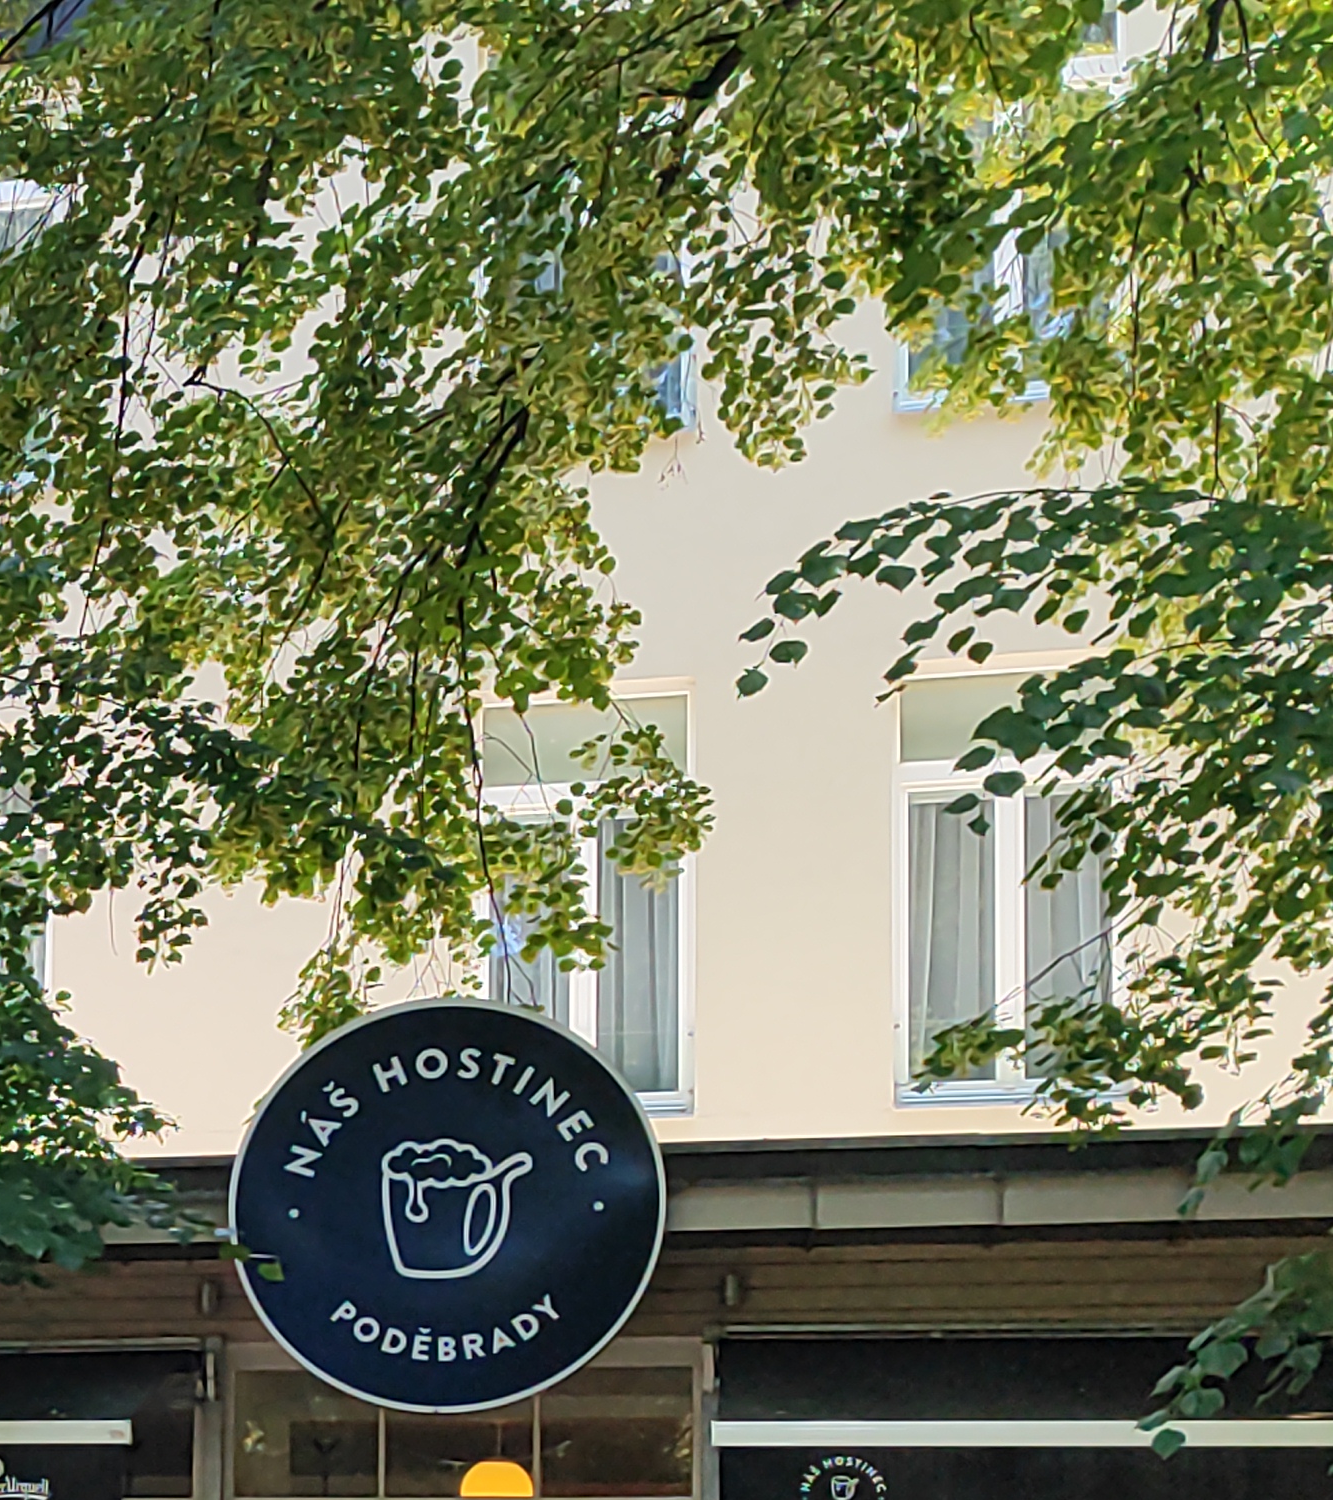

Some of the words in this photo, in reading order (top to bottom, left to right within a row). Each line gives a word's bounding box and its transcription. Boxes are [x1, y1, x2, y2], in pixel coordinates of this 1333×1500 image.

[284, 1081, 360, 1178] NÁŠ
[372, 1047, 609, 1173] HOSTINEC
[330, 1294, 561, 1363] PODĚBRADY
[822, 1456, 887, 1493] HOSTINEC
